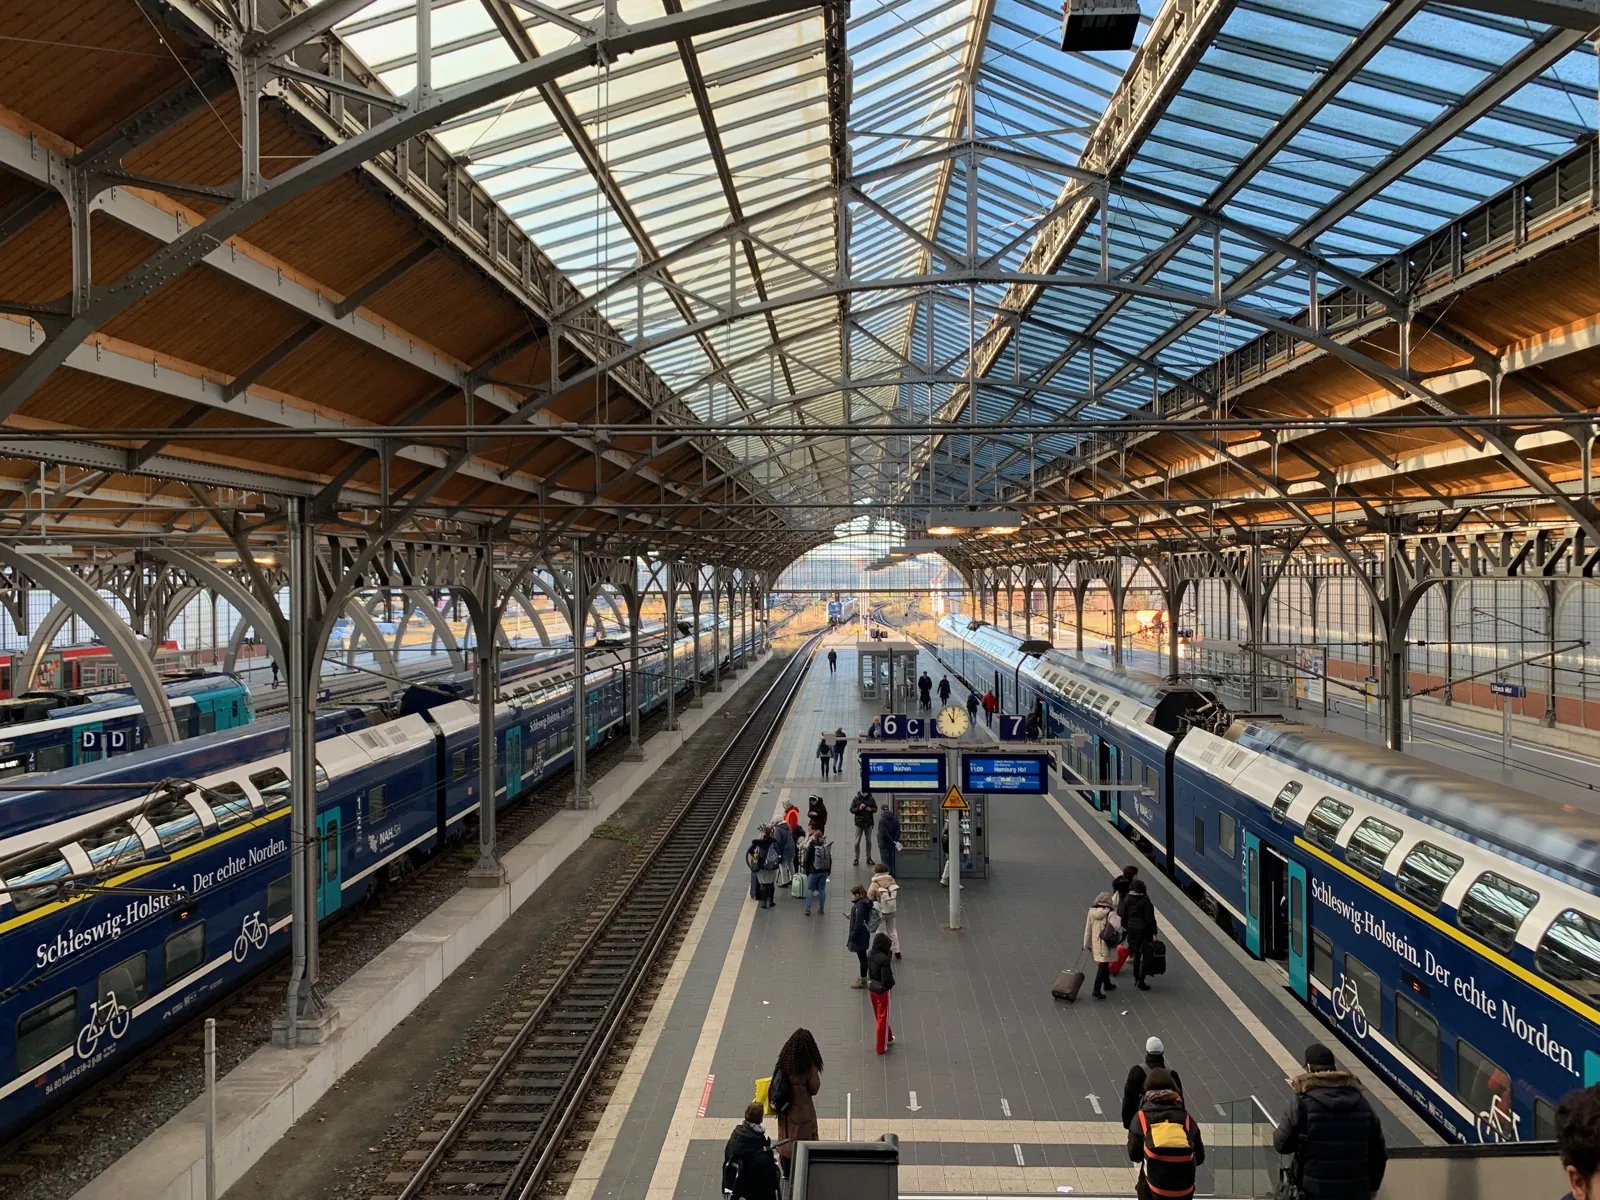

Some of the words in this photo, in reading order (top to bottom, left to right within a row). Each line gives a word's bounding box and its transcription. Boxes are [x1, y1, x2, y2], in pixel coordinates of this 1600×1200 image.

[884, 714, 897, 735] 6
[907, 719, 919, 735] C
[1009, 716, 1022, 735] 7
[83, 732, 95, 747] D
[112, 732, 124, 747] D
[192, 873, 213, 894] Der
[216, 855, 246, 883] echte
[248, 838, 288, 868] Norden.
[1311, 877, 1422, 968] Schleswig-Holstein.
[1425, 950, 1451, 987] Der
[1454, 977, 1497, 1020] echte
[1501, 1001, 1580, 1078] Norden.
